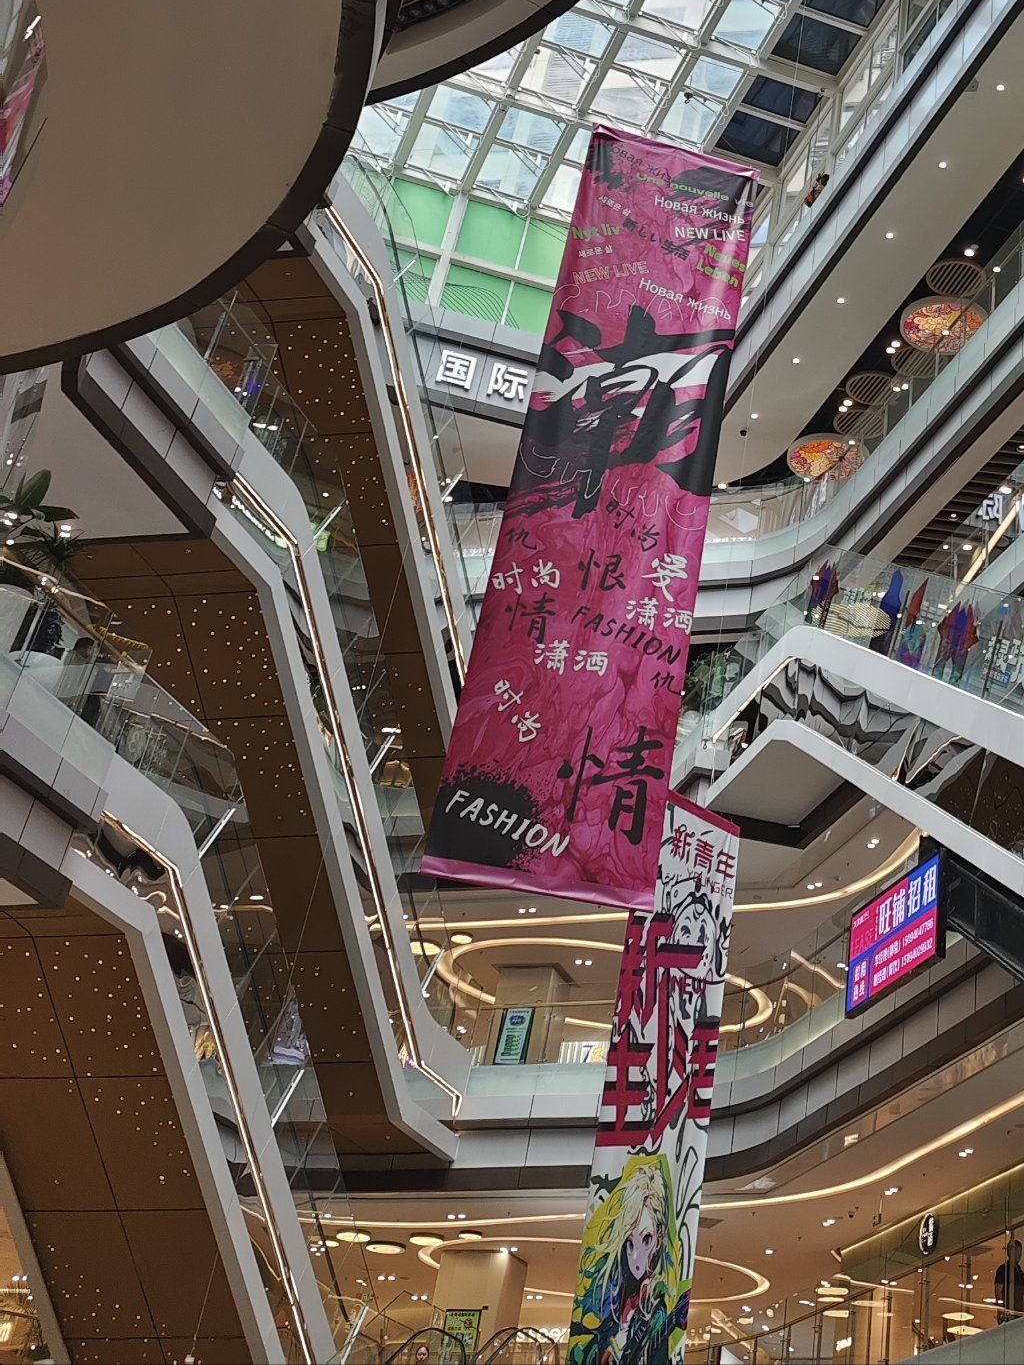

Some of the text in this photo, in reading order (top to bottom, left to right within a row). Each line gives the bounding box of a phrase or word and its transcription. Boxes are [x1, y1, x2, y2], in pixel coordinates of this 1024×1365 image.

[654, 194, 745, 226] Новая жизнь
[674, 226, 747, 243] NEW LIVE
[573, 260, 650, 286] NEW LIVE
[638, 276, 733, 321] Новая жизнь
[435, 348, 529, 402] 国际
[492, 558, 561, 595] 时尚
[578, 548, 626, 592] 恨
[504, 591, 556, 644] 情
[570, 605, 682, 666] FASHION
[533, 639, 609, 676] 潇洒
[493, 678, 543, 742] 时尚
[556, 725, 665, 846] 情
[445, 789, 571, 858] FASHION
[671, 828, 736, 881] 新青年
[878, 864, 937, 935] 旺铺招租
